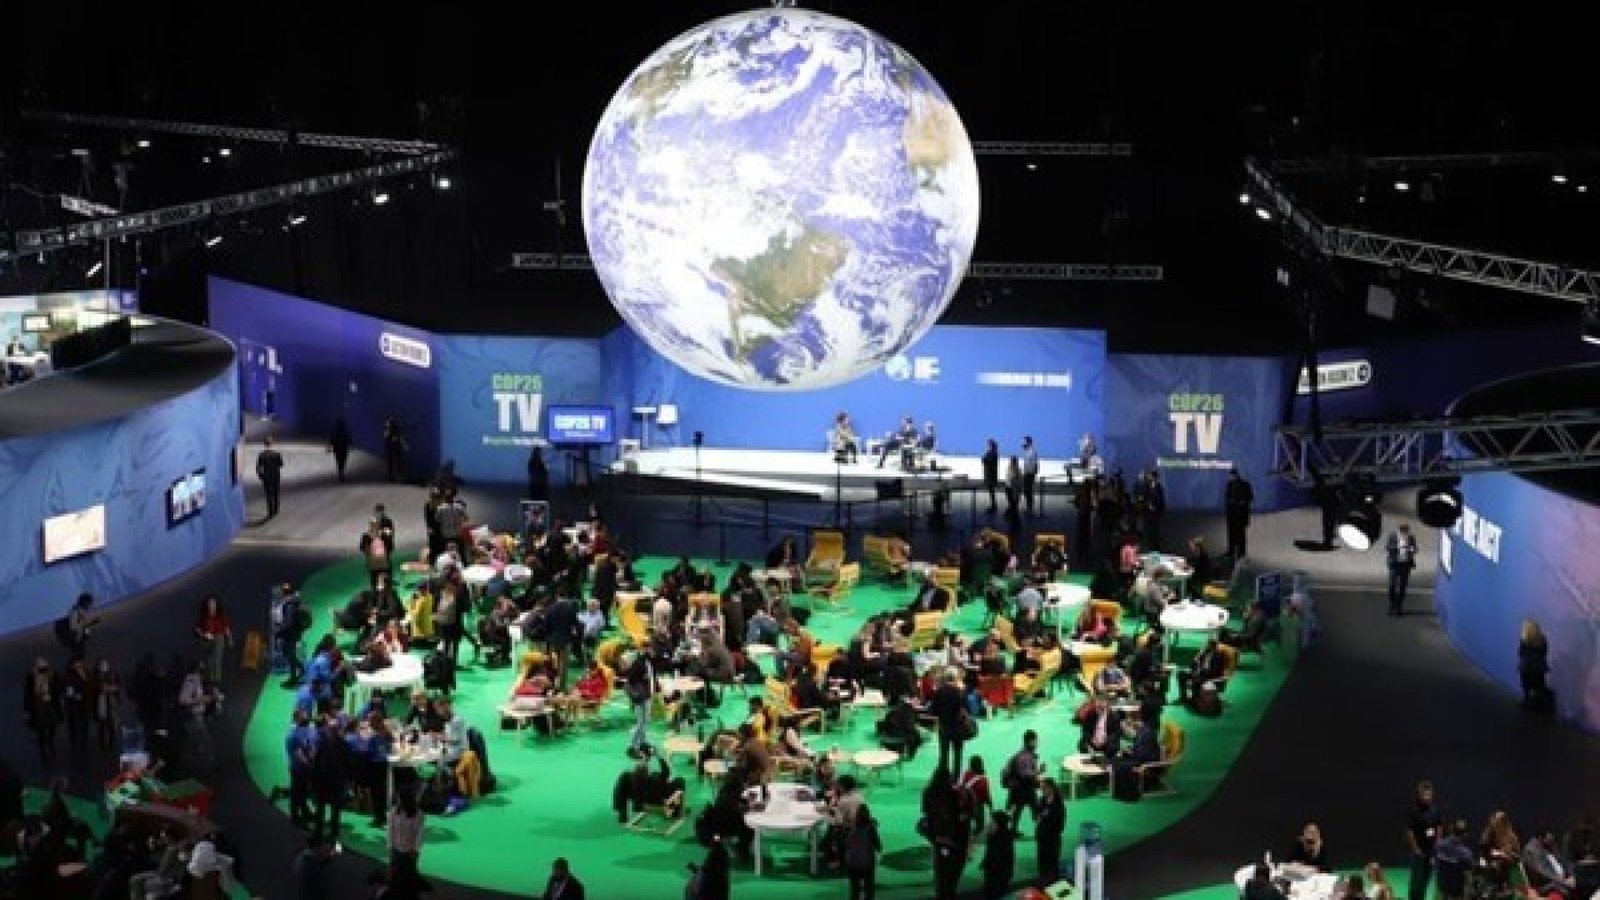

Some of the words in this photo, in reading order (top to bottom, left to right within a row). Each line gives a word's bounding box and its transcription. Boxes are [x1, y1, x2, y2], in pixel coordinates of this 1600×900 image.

[492, 373, 543, 390] COP26
[492, 393, 542, 432] TV
[1169, 393, 1224, 411] COP26
[1169, 412, 1223, 454] TV
